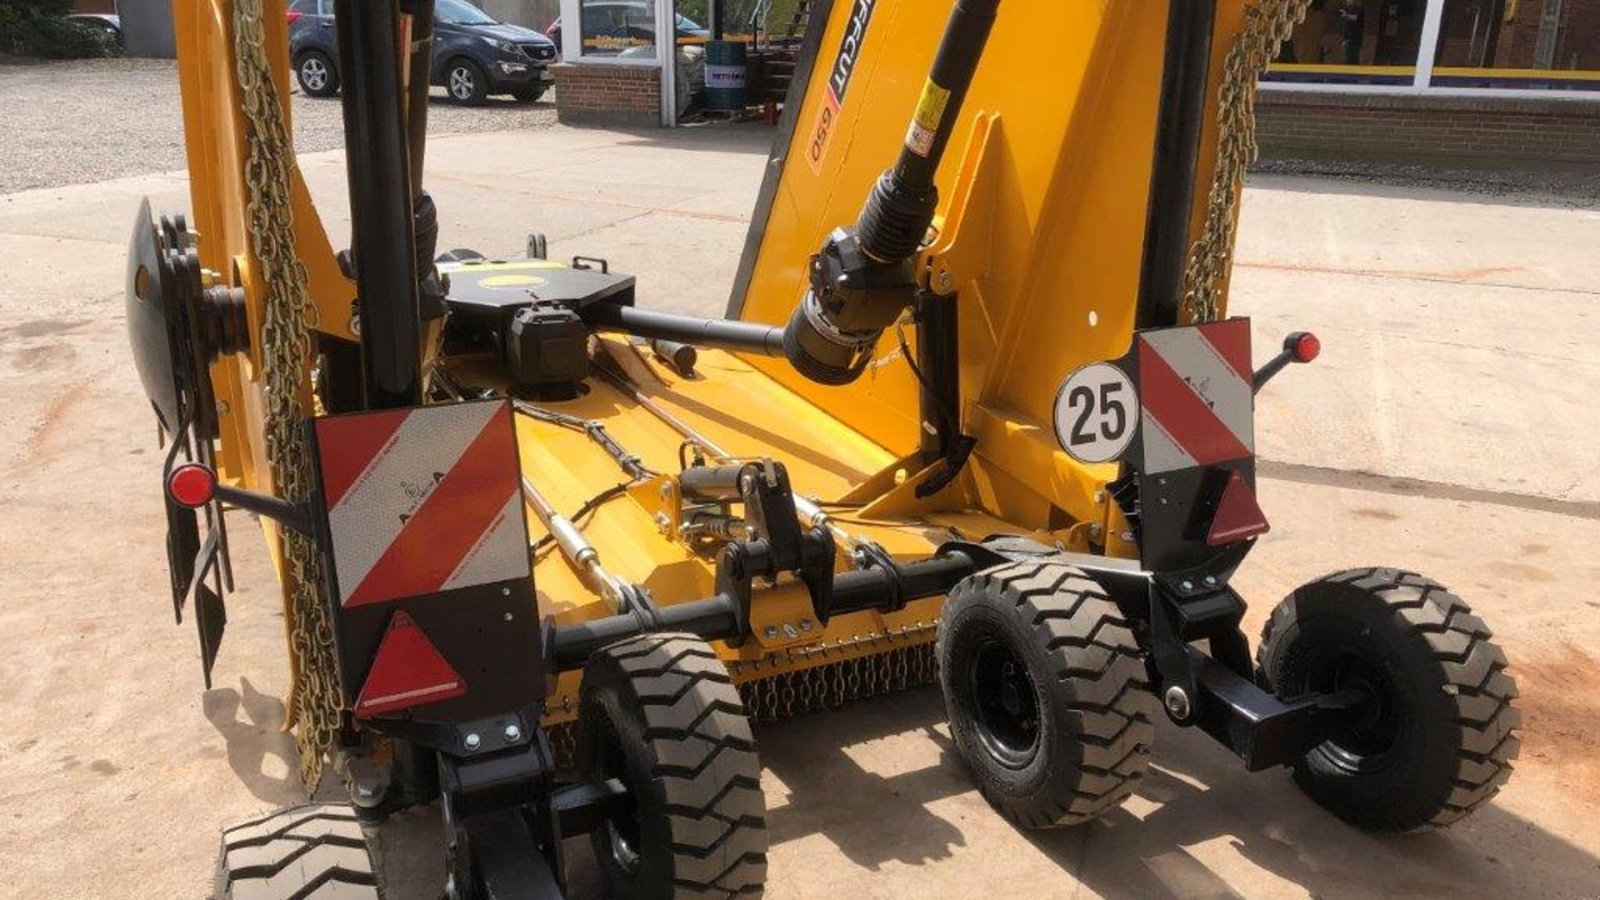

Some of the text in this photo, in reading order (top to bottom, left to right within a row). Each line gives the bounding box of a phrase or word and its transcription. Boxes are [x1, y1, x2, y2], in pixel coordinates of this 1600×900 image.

[811, 0, 871, 161] FFCUT 650
[1069, 382, 1126, 446] 25
